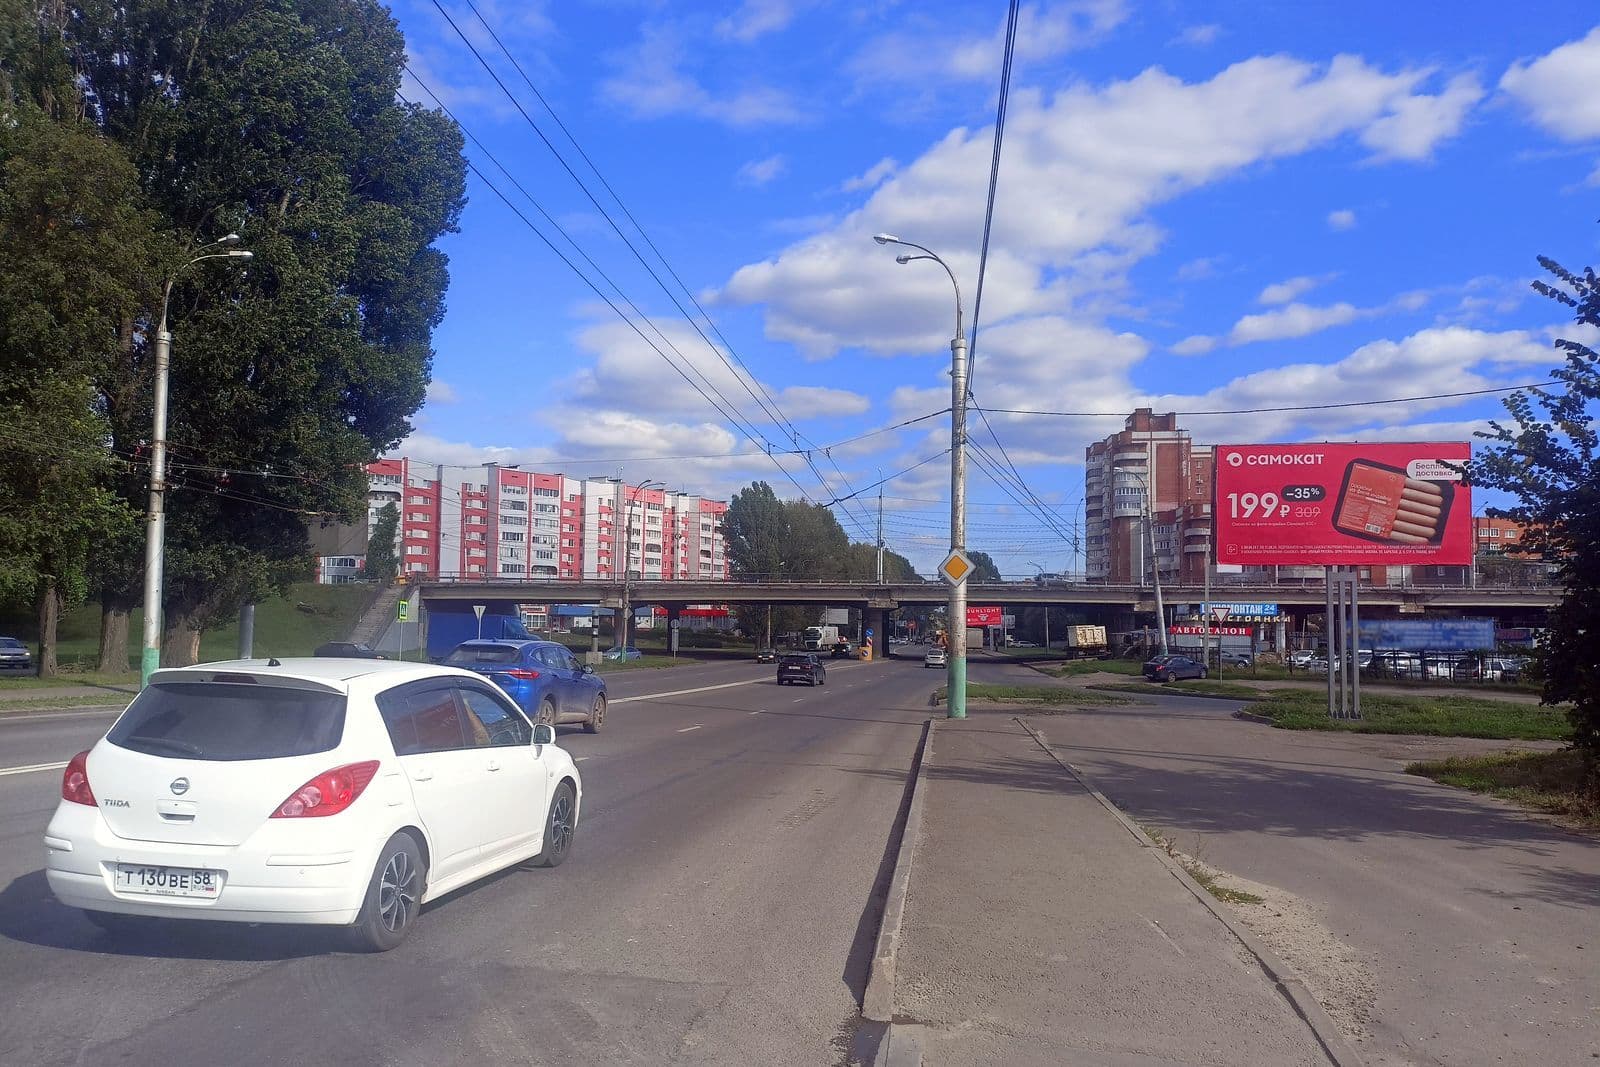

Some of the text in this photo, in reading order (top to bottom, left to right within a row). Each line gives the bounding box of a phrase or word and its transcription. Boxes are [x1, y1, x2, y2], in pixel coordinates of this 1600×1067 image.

[1247, 454, 1324, 465] самокат
[1294, 506, 1321, 518] 309
[1176, 626, 1246, 635] АВТОСАЛОН
[104, 798, 130, 808] TIIDA
